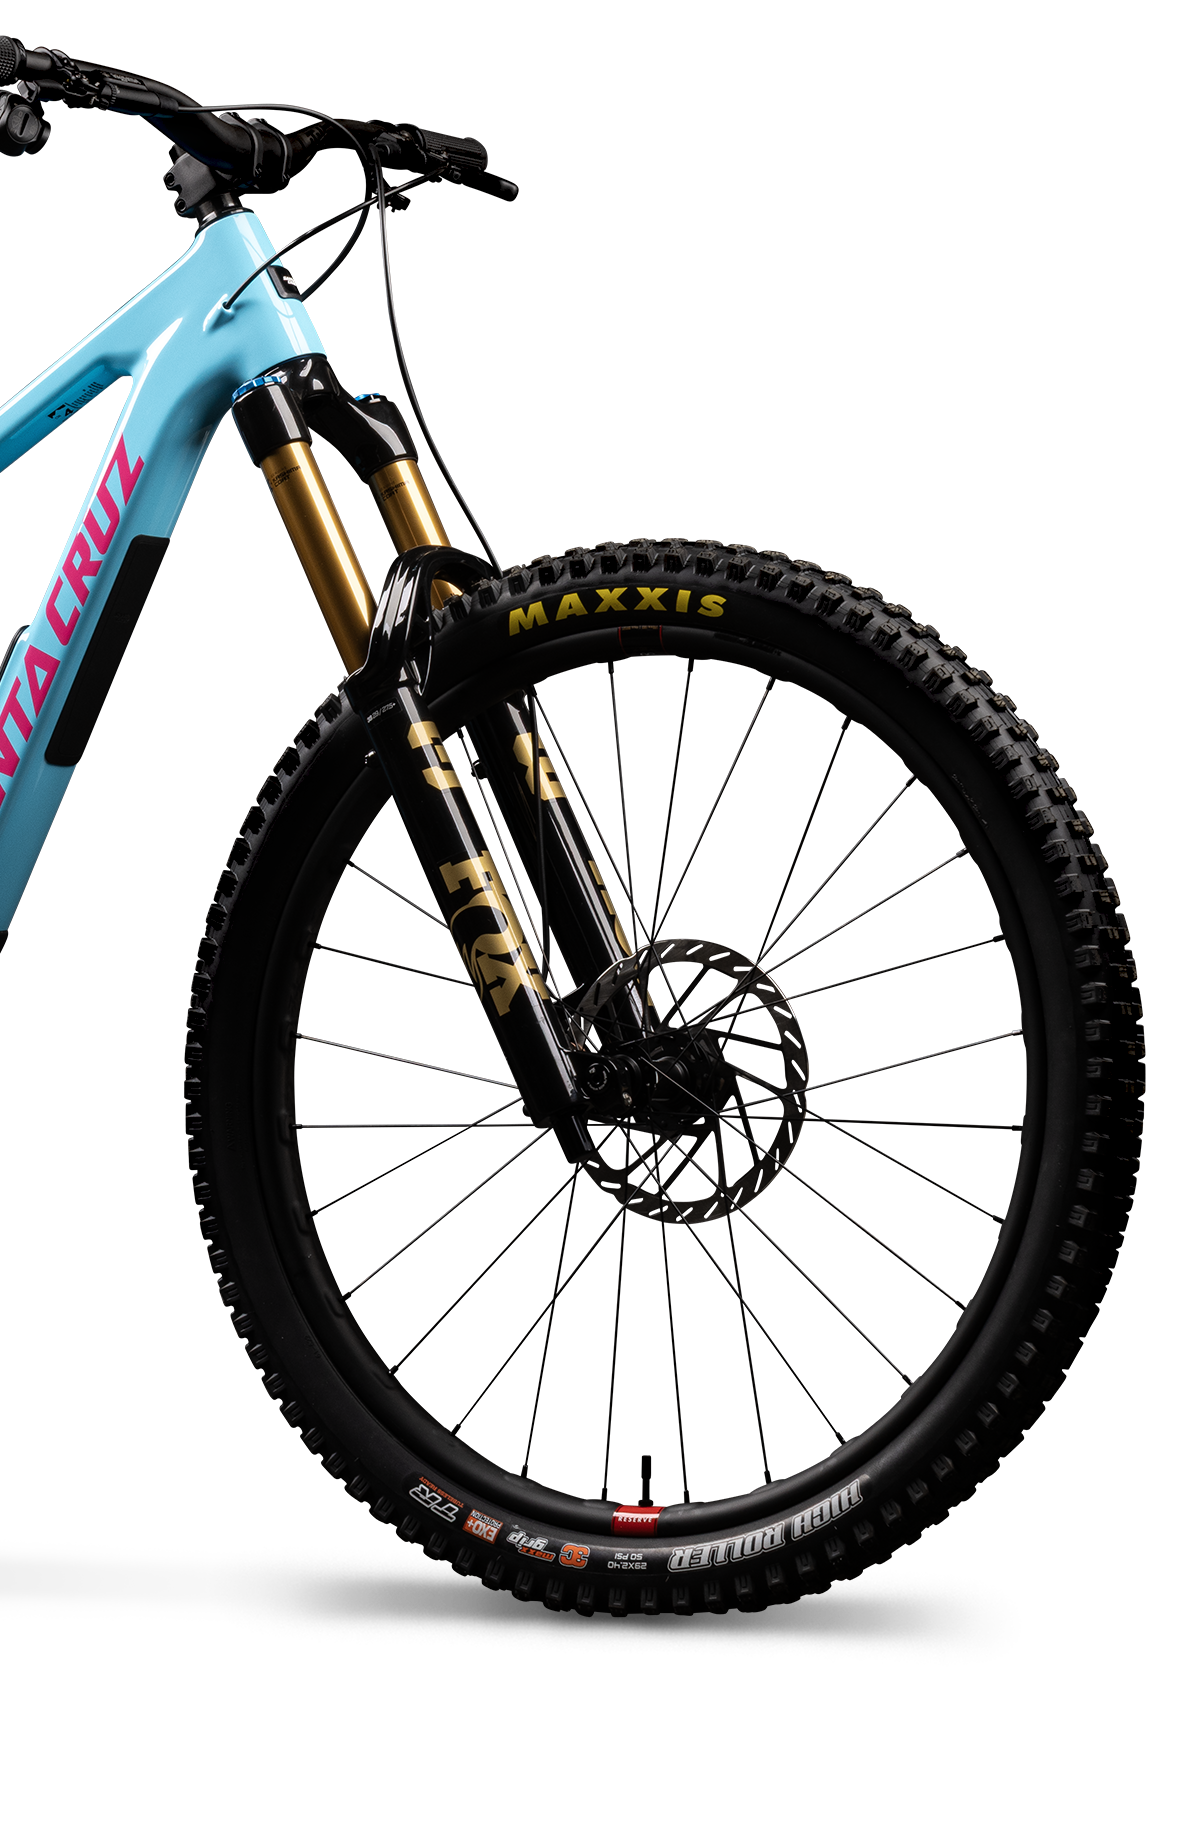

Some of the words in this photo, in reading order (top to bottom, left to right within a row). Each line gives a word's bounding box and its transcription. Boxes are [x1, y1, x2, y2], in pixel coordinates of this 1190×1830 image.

[45, 434, 145, 647] CRUZ
[508, 587, 728, 637] MAXXIS
[439, 850, 550, 1017] FOX
[418, 1476, 438, 1493] READY
[408, 1483, 461, 1523] TR
[437, 1486, 465, 1508] TUBELESS
[471, 1510, 502, 1529] PROTECTION
[617, 1515, 653, 1524] RESERVE
[791, 1478, 864, 1542] HIGH
[466, 1518, 496, 1542] EXO+
[506, 1531, 549, 1551] grip
[519, 1546, 556, 1562] maxx
[558, 1543, 590, 1569] 3C
[614, 1552, 630, 1560] PSI
[630, 1553, 643, 1561] 50
[667, 1521, 785, 1573] ROLLER
[607, 1561, 648, 1570] 29X2.40
